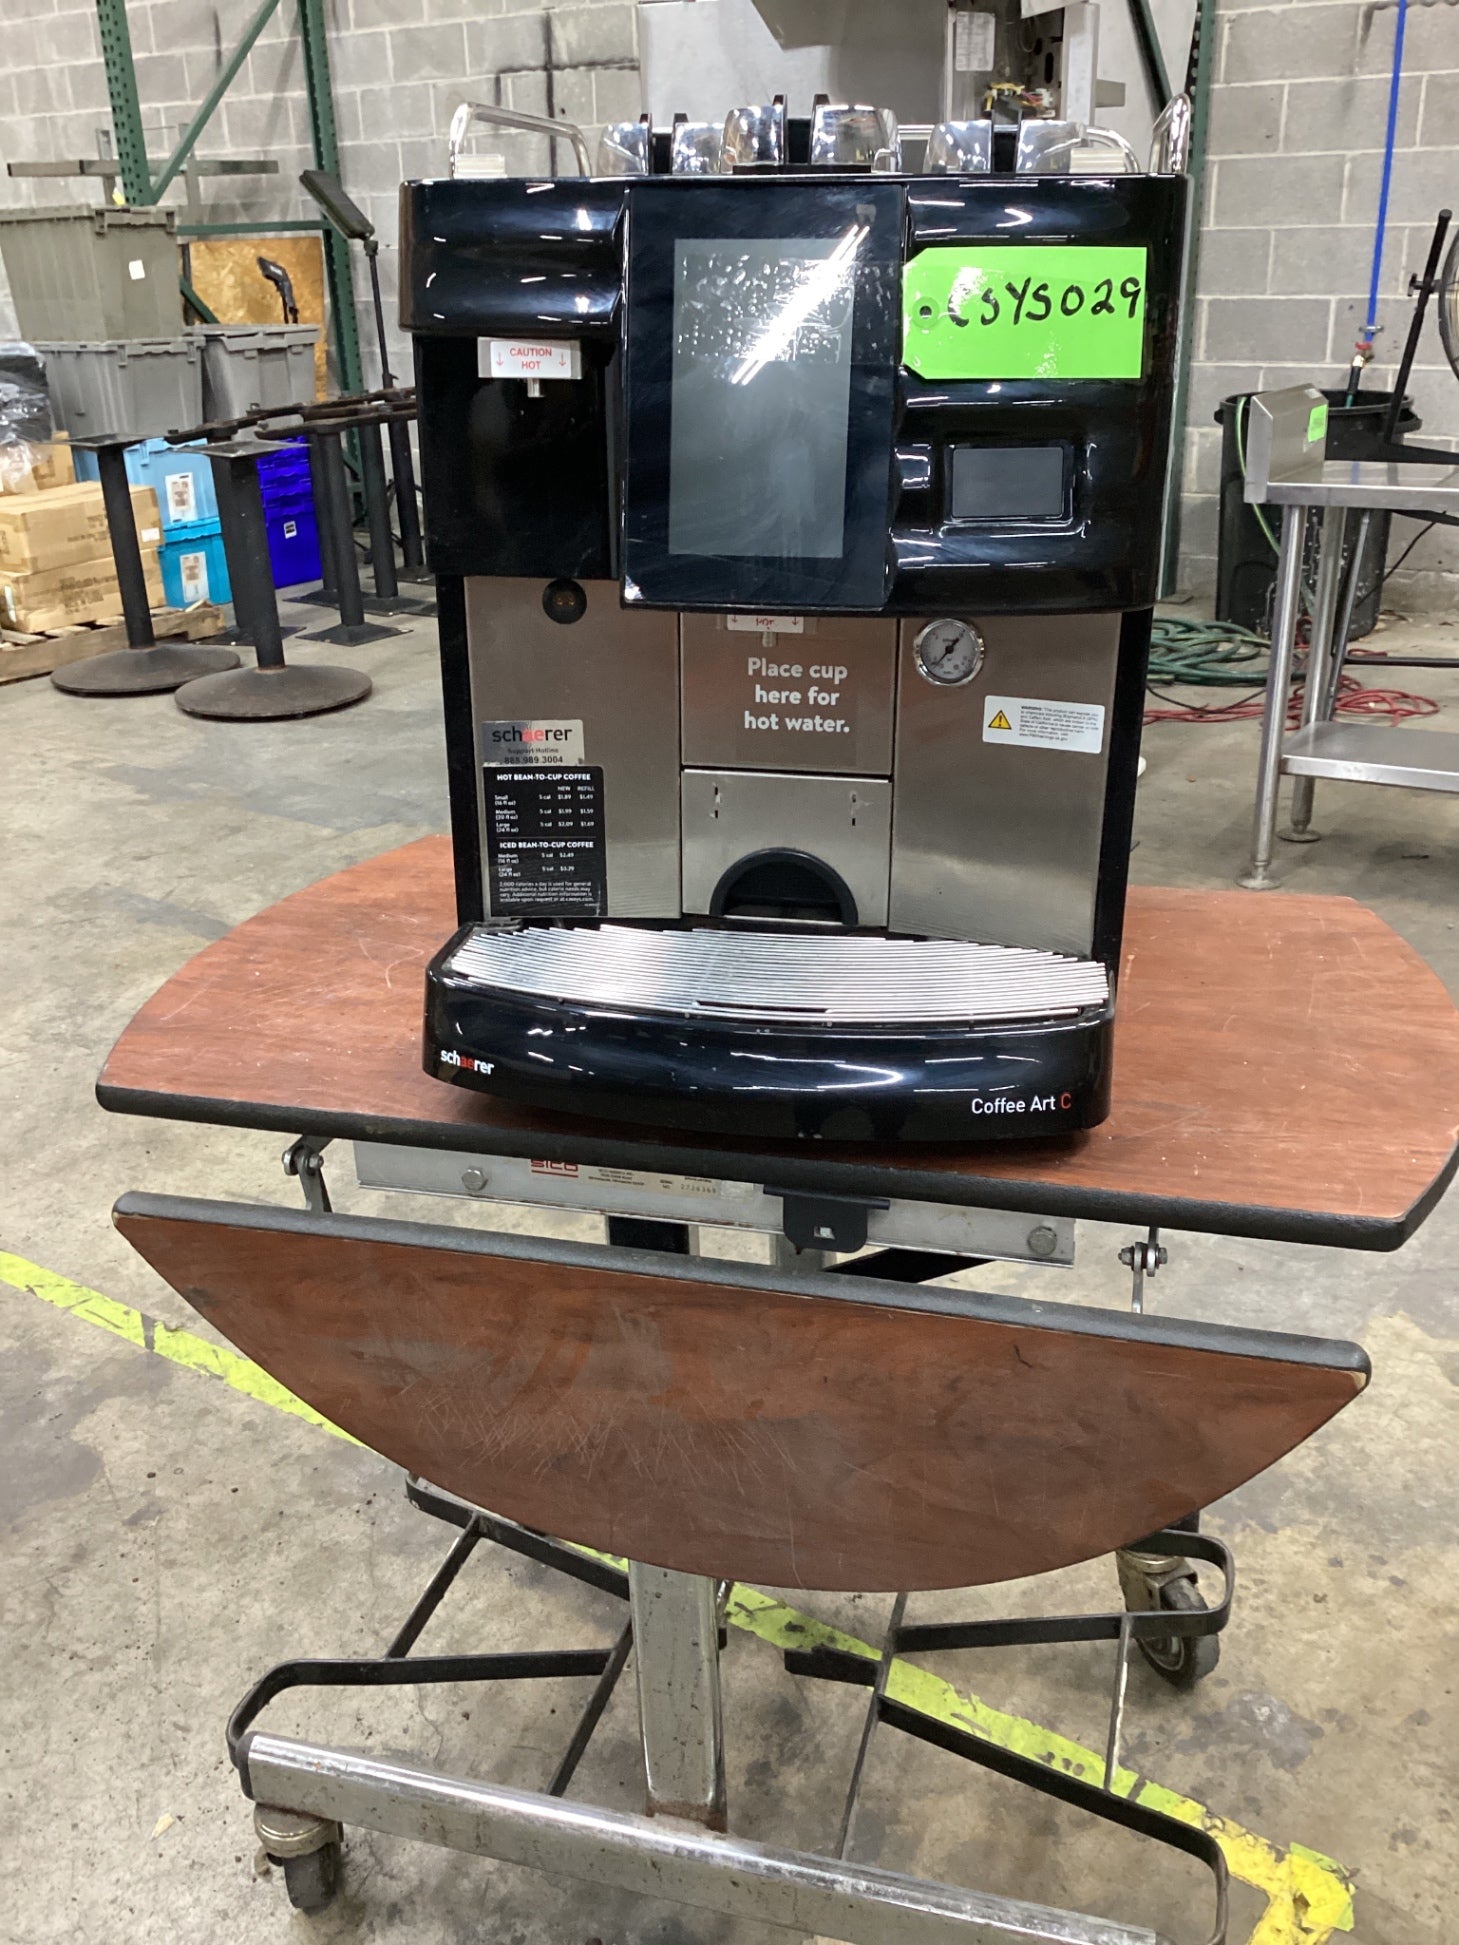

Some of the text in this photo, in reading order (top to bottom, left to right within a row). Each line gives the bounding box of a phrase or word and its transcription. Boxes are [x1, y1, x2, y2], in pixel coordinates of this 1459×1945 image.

[948, 276, 1142, 327] CSYS029
[510, 347, 552, 356] CAUTION
[521, 361, 541, 370] HOT
[747, 657, 848, 685] Place cup
[755, 684, 840, 705] here for
[744, 710, 850, 733] hot water.
[492, 726, 572, 742] schaerer
[440, 1050, 495, 1075] schaerer
[971, 1092, 1072, 1114] Coffee Art C
